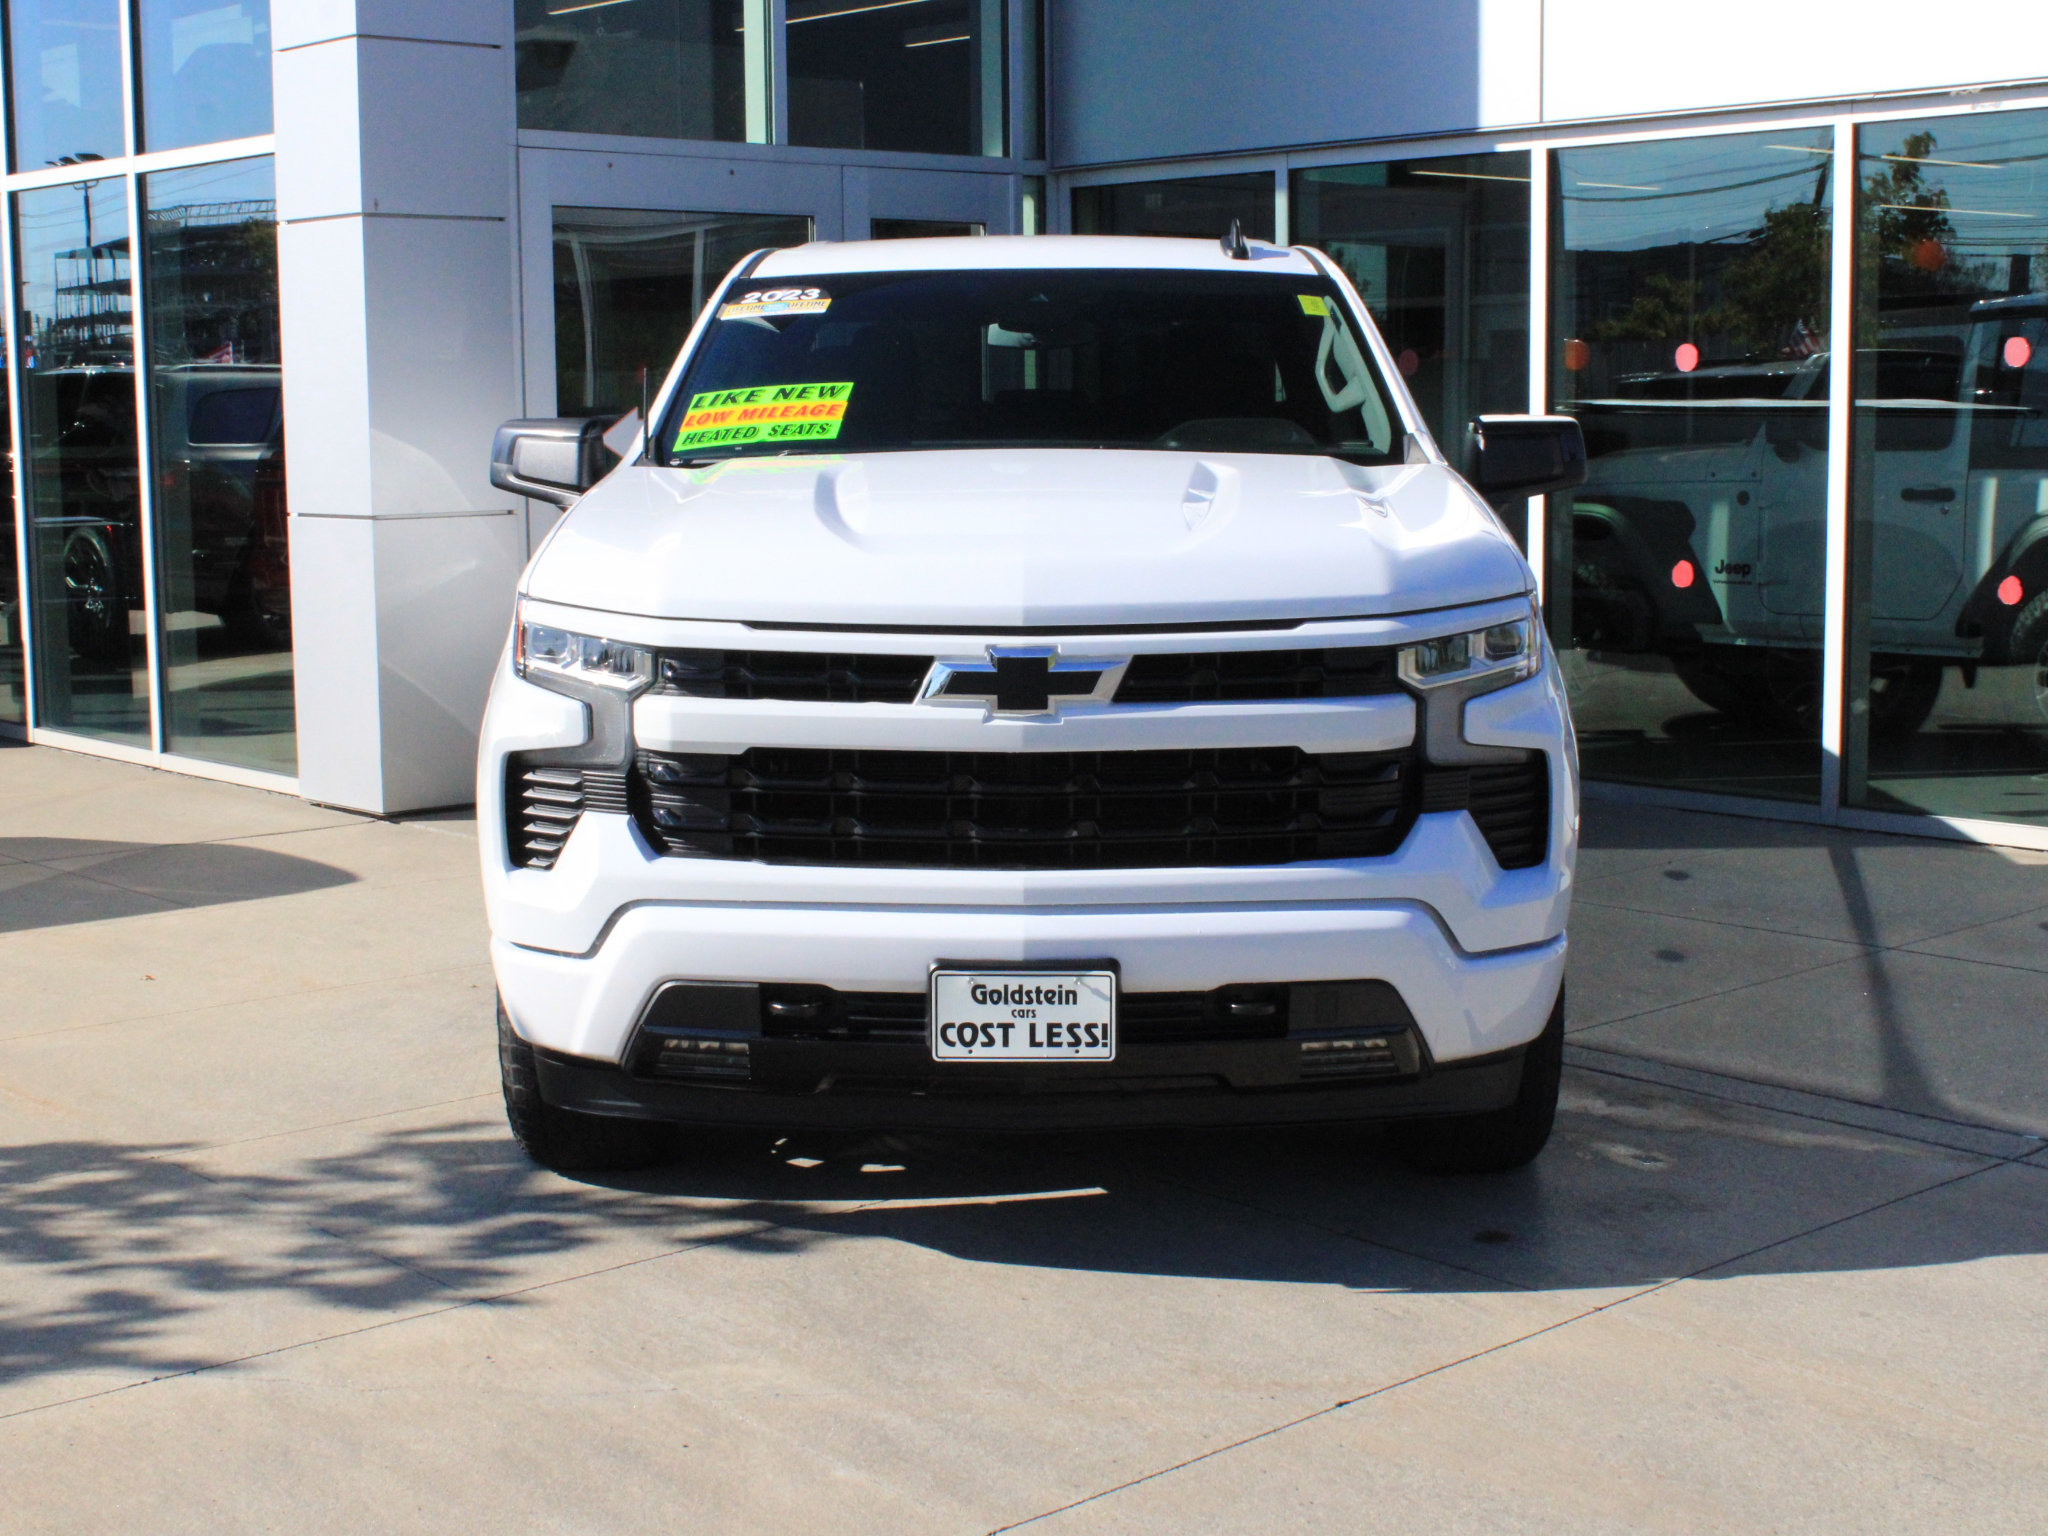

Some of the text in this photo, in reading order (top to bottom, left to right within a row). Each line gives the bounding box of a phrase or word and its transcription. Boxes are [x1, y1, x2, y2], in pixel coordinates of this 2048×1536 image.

[741, 288, 821, 304] 2023
[787, 300, 826, 309] LIFETIME
[692, 385, 849, 409] LIKE NEW
[685, 404, 843, 426] LOW MILEAGE
[682, 422, 831, 445] HEATED SEATS
[1714, 559, 1752, 577] Jeep
[970, 984, 1078, 1005] Goldstein
[1011, 1008, 1037, 1019] cars
[940, 1022, 1109, 1048] COST LESS!
